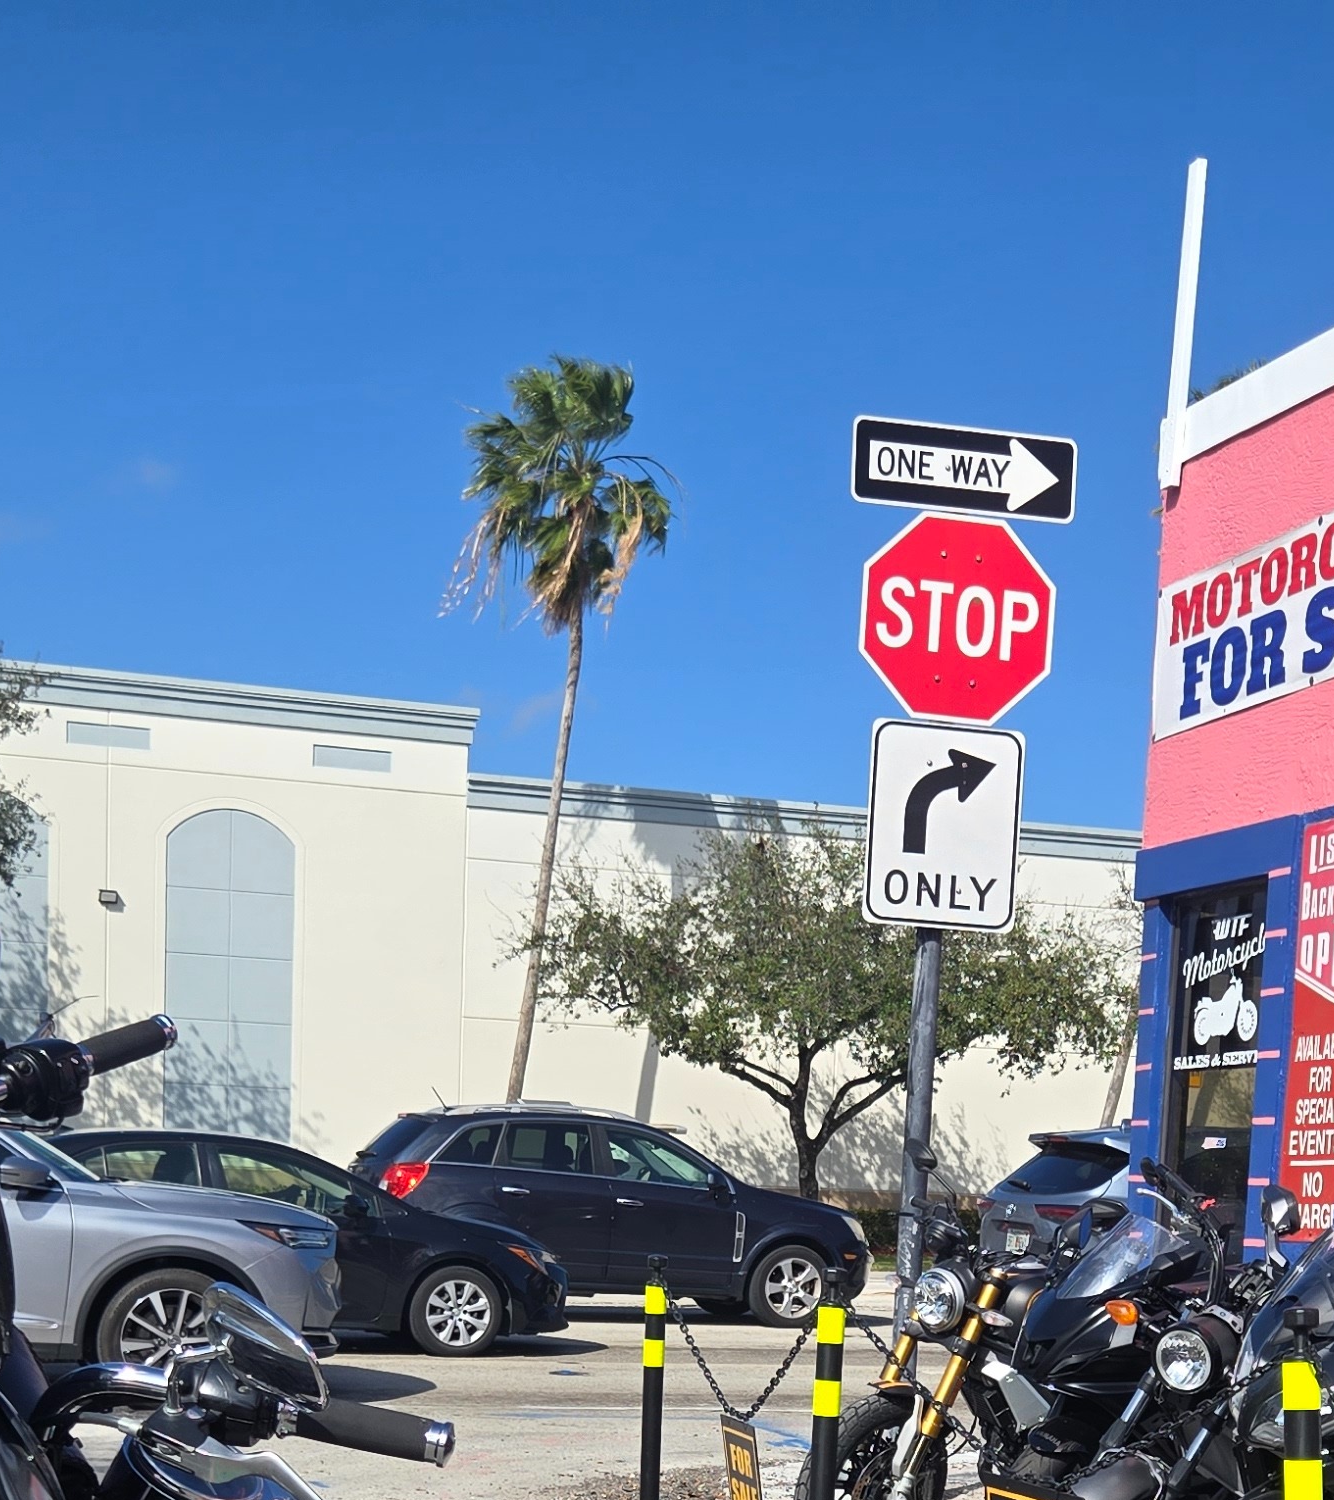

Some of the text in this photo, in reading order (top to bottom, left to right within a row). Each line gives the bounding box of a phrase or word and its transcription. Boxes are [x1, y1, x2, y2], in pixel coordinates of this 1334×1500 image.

[876, 445, 1010, 488] ONE WAY
[875, 575, 1040, 662] STOP
[1179, 609, 1288, 721] FOR
[884, 868, 998, 913] ONLY
[1211, 913, 1253, 941] WTF
[1173, 1053, 1210, 1071] SALES
[1211, 1053, 1221, 1068] &
[1308, 1065, 1332, 1093] FOR
[1302, 1171, 1323, 1198] NO
[729, 1443, 754, 1479] FOR
